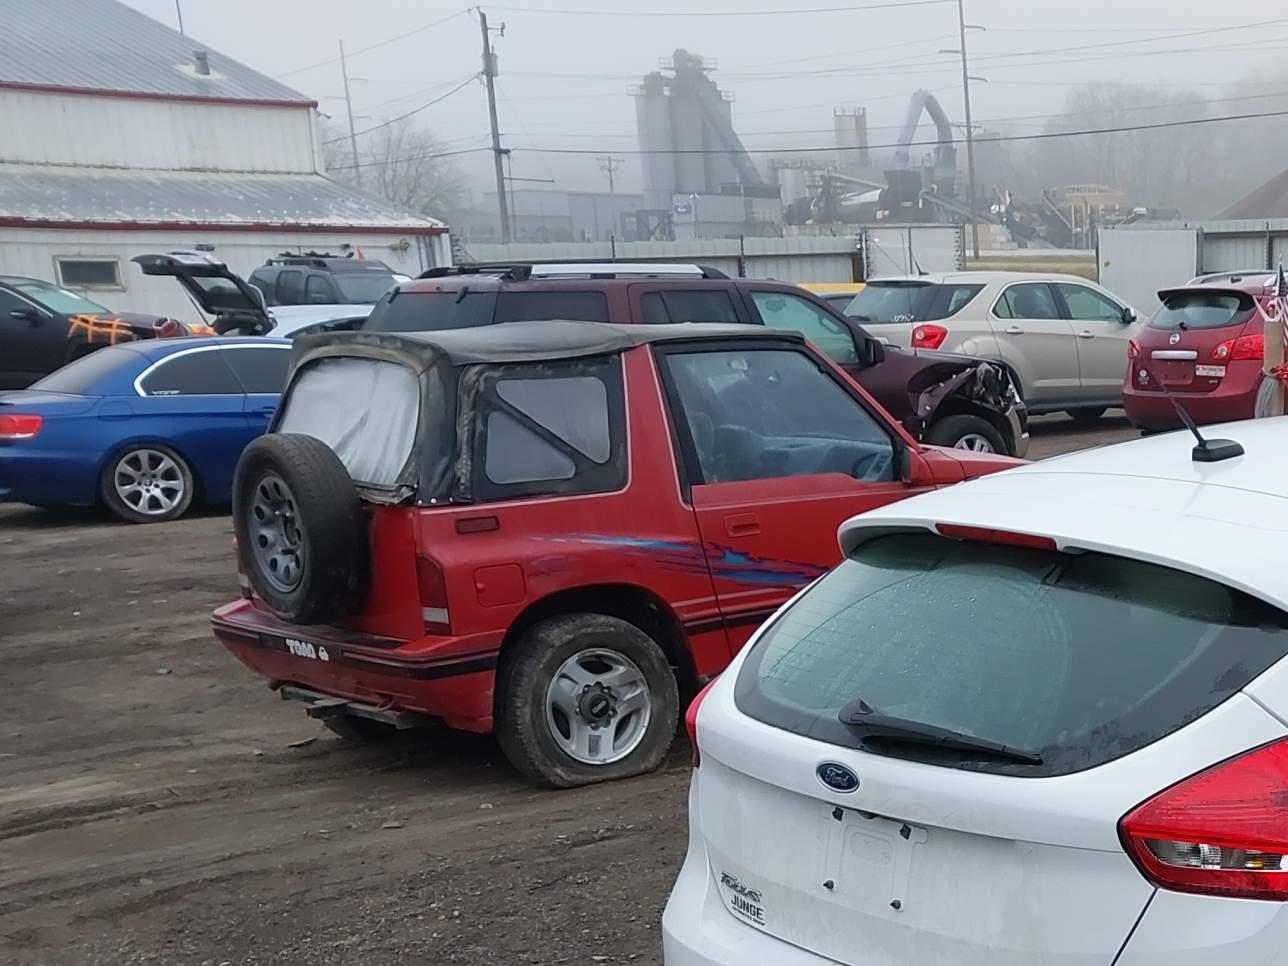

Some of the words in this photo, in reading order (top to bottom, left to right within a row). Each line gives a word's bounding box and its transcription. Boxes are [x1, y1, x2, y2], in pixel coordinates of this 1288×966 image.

[285, 638, 317, 659] TOAD
[825, 766, 850, 787] Ford
[731, 894, 764, 921] JUNGE
